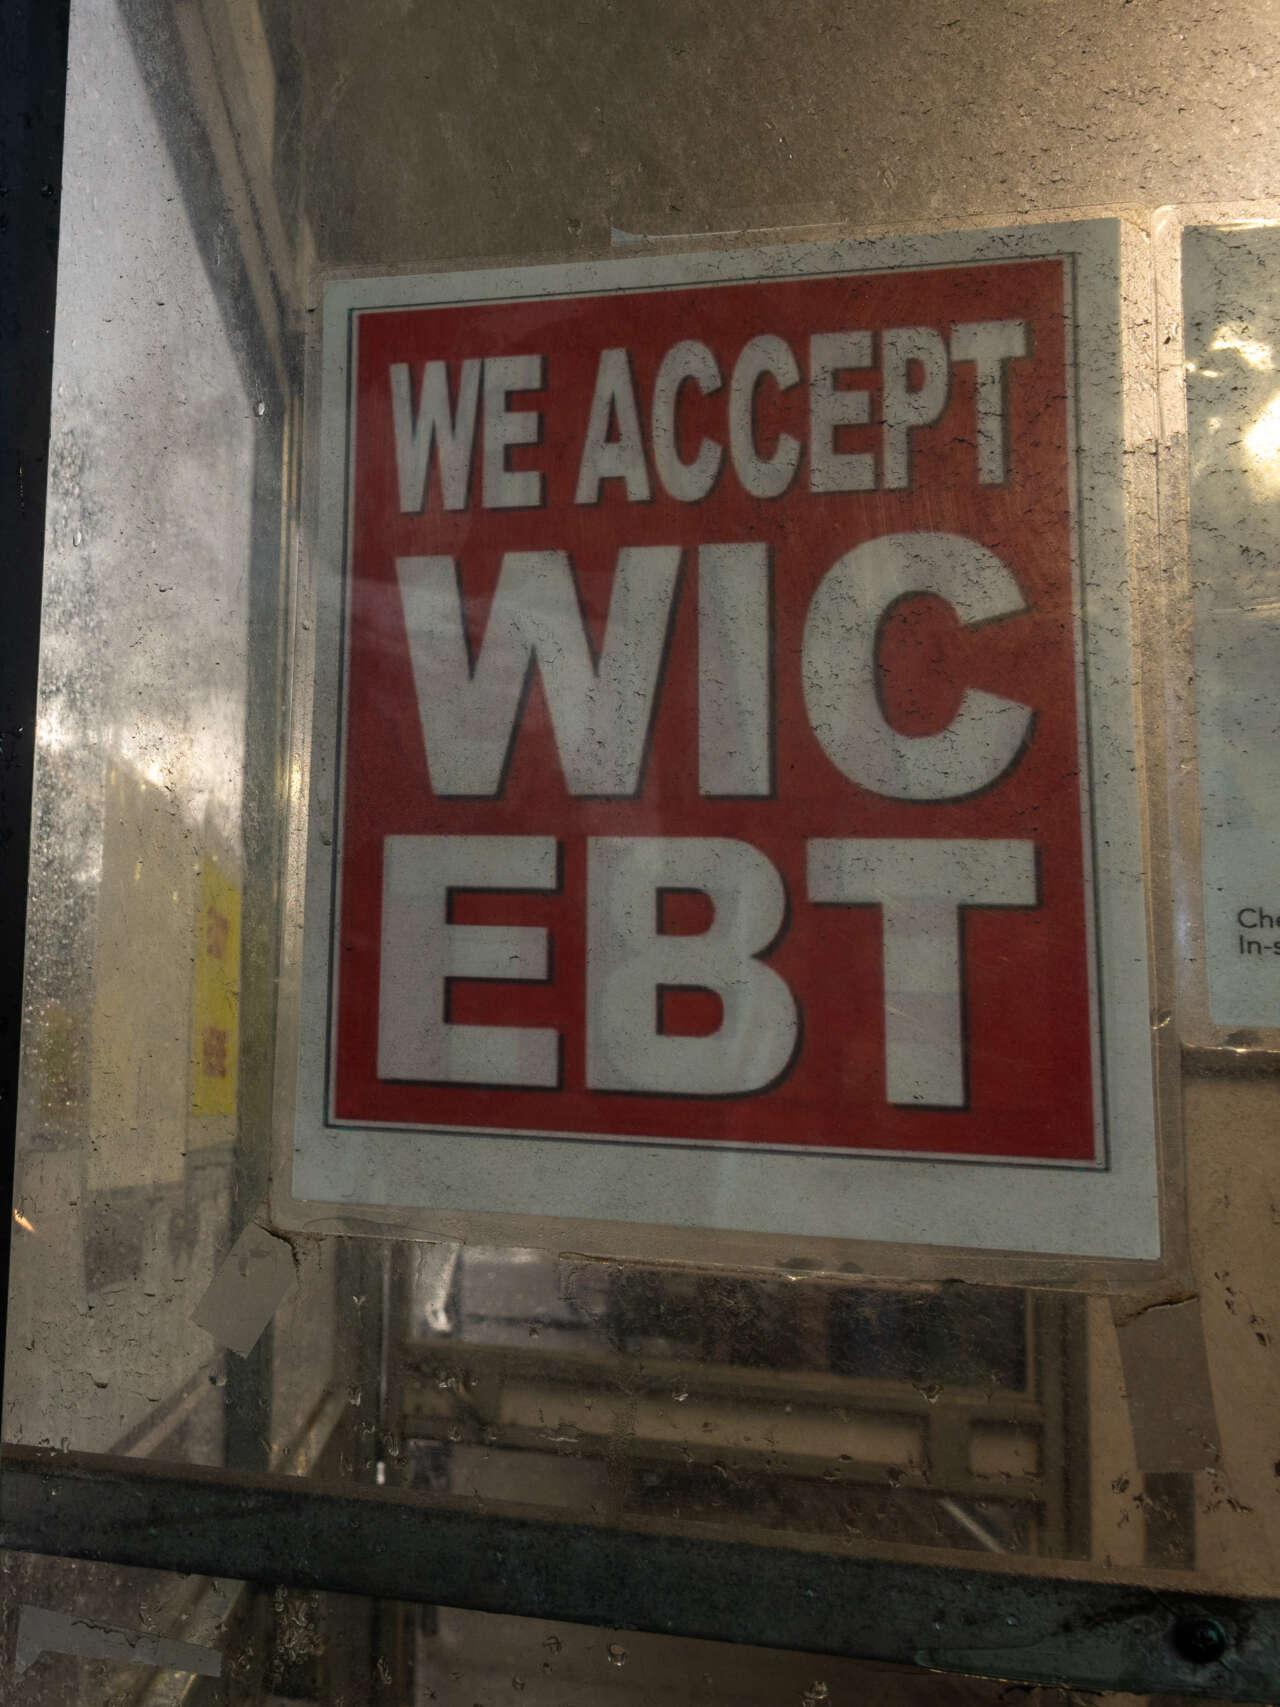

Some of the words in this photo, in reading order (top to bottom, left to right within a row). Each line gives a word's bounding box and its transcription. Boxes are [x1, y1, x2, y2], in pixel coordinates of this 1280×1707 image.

[390, 355, 546, 513] WE
[574, 320, 1030, 505] ACCEPT
[395, 531, 1035, 801] WIC
[377, 835, 1041, 1109] EBT
